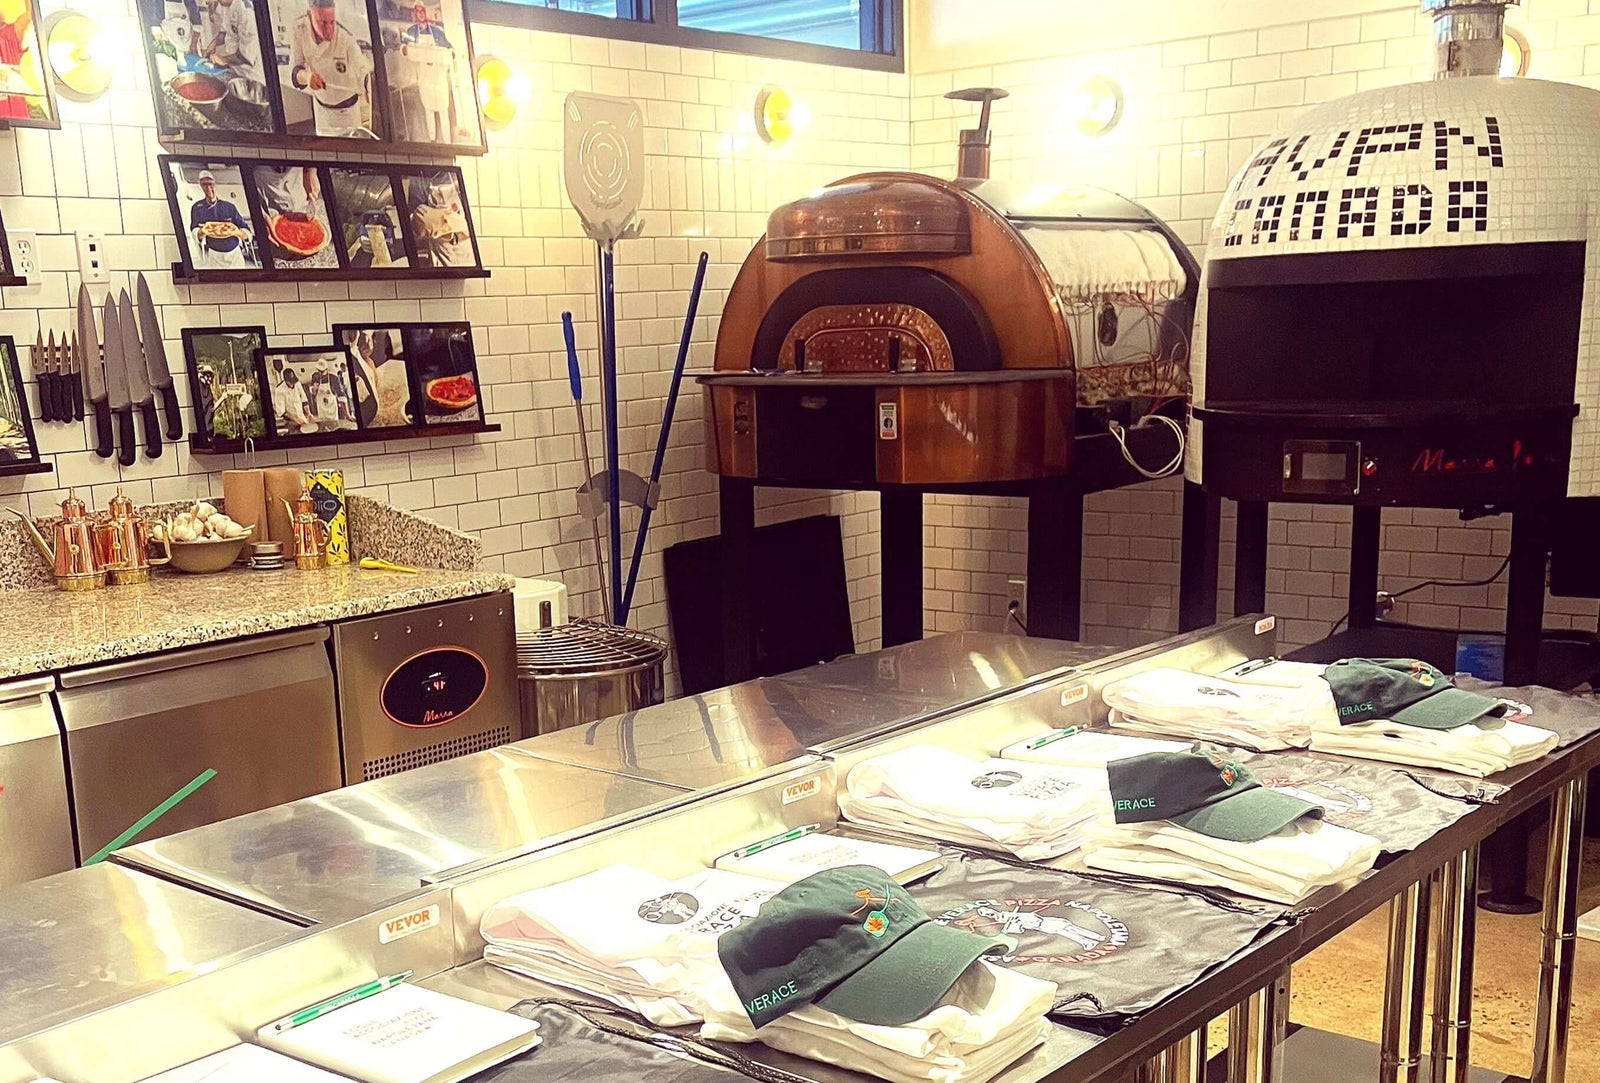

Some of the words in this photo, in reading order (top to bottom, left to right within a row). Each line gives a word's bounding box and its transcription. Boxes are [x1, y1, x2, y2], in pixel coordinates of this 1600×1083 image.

[1224, 180, 1489, 247] CANADA
[786, 780, 815, 797] VEVOR
[1004, 897, 1060, 907] PIZZA
[386, 909, 431, 934] VEVOR
[744, 980, 799, 1014] VERACE
